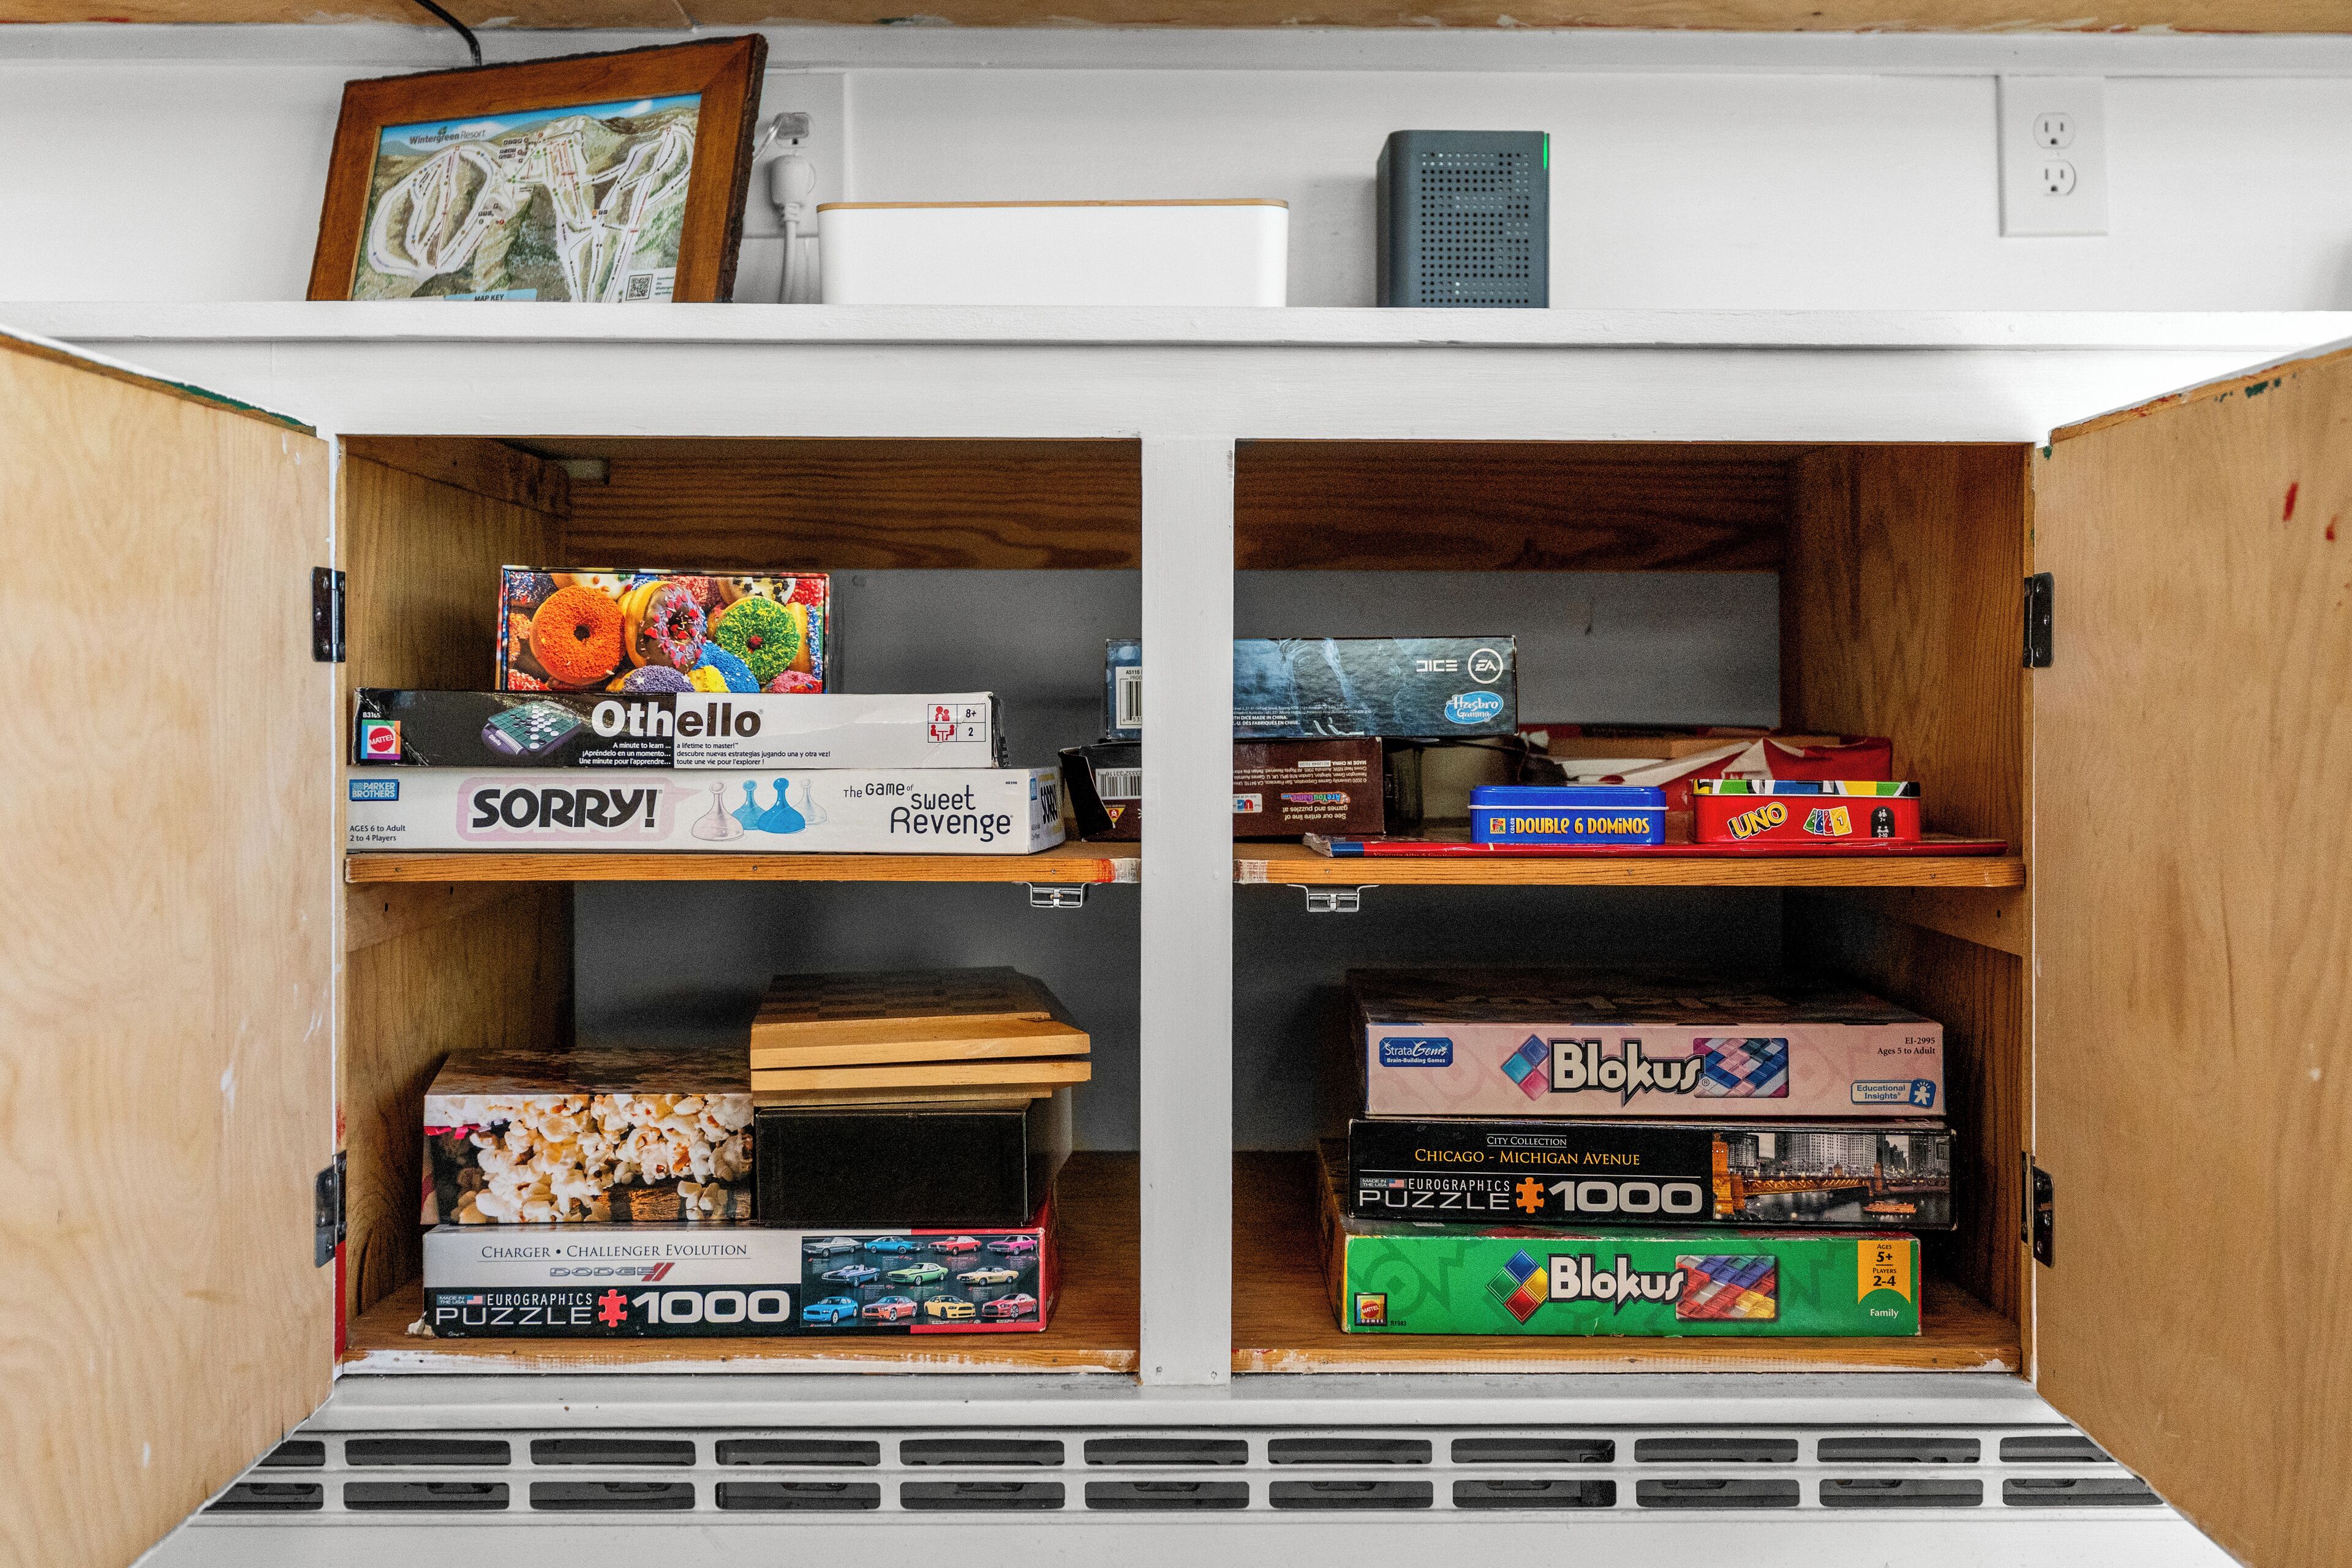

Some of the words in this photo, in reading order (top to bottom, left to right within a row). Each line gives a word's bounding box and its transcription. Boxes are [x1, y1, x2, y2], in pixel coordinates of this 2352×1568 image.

[409, 133, 459, 145] Wintergreen
[461, 129, 486, 140] Resort
[1475, 659, 1497, 671] EA
[1449, 696, 1499, 712] Hasbro
[592, 701, 761, 737] Othello
[966, 709, 976, 718] 8+
[1457, 708, 1491, 720] Gaming
[968, 727, 973, 736] 2
[369, 734, 394, 746] MATTEL
[843, 786, 862, 797] The
[911, 785, 976, 810] sweet
[473, 789, 658, 828] SORRY!
[891, 807, 1010, 842] Revenge
[1574, 818, 1583, 834] 6
[1728, 803, 1787, 839] UNO
[1838, 816, 1844, 826] 1
[1878, 1047, 1895, 1056] Ages
[1551, 1041, 1703, 1101] Blokus
[1409, 1178, 1510, 1191] EUROGRAPHICS
[1359, 1190, 1510, 1210] PUZZLE
[1548, 1181, 1702, 1213] 1000
[1876, 1251, 1893, 1262] 5+
[550, 1266, 656, 1277] DODGE
[1549, 1254, 1686, 1311] Blokus
[1873, 1275, 1896, 1286] 2-4
[488, 1293, 592, 1306] EUROGRAPHICS
[436, 1307, 592, 1325] PUZZLE
[631, 1290, 790, 1324] 1000
[1362, 1305, 1379, 1314] MATTEL
[1870, 1308, 1899, 1319] Family
